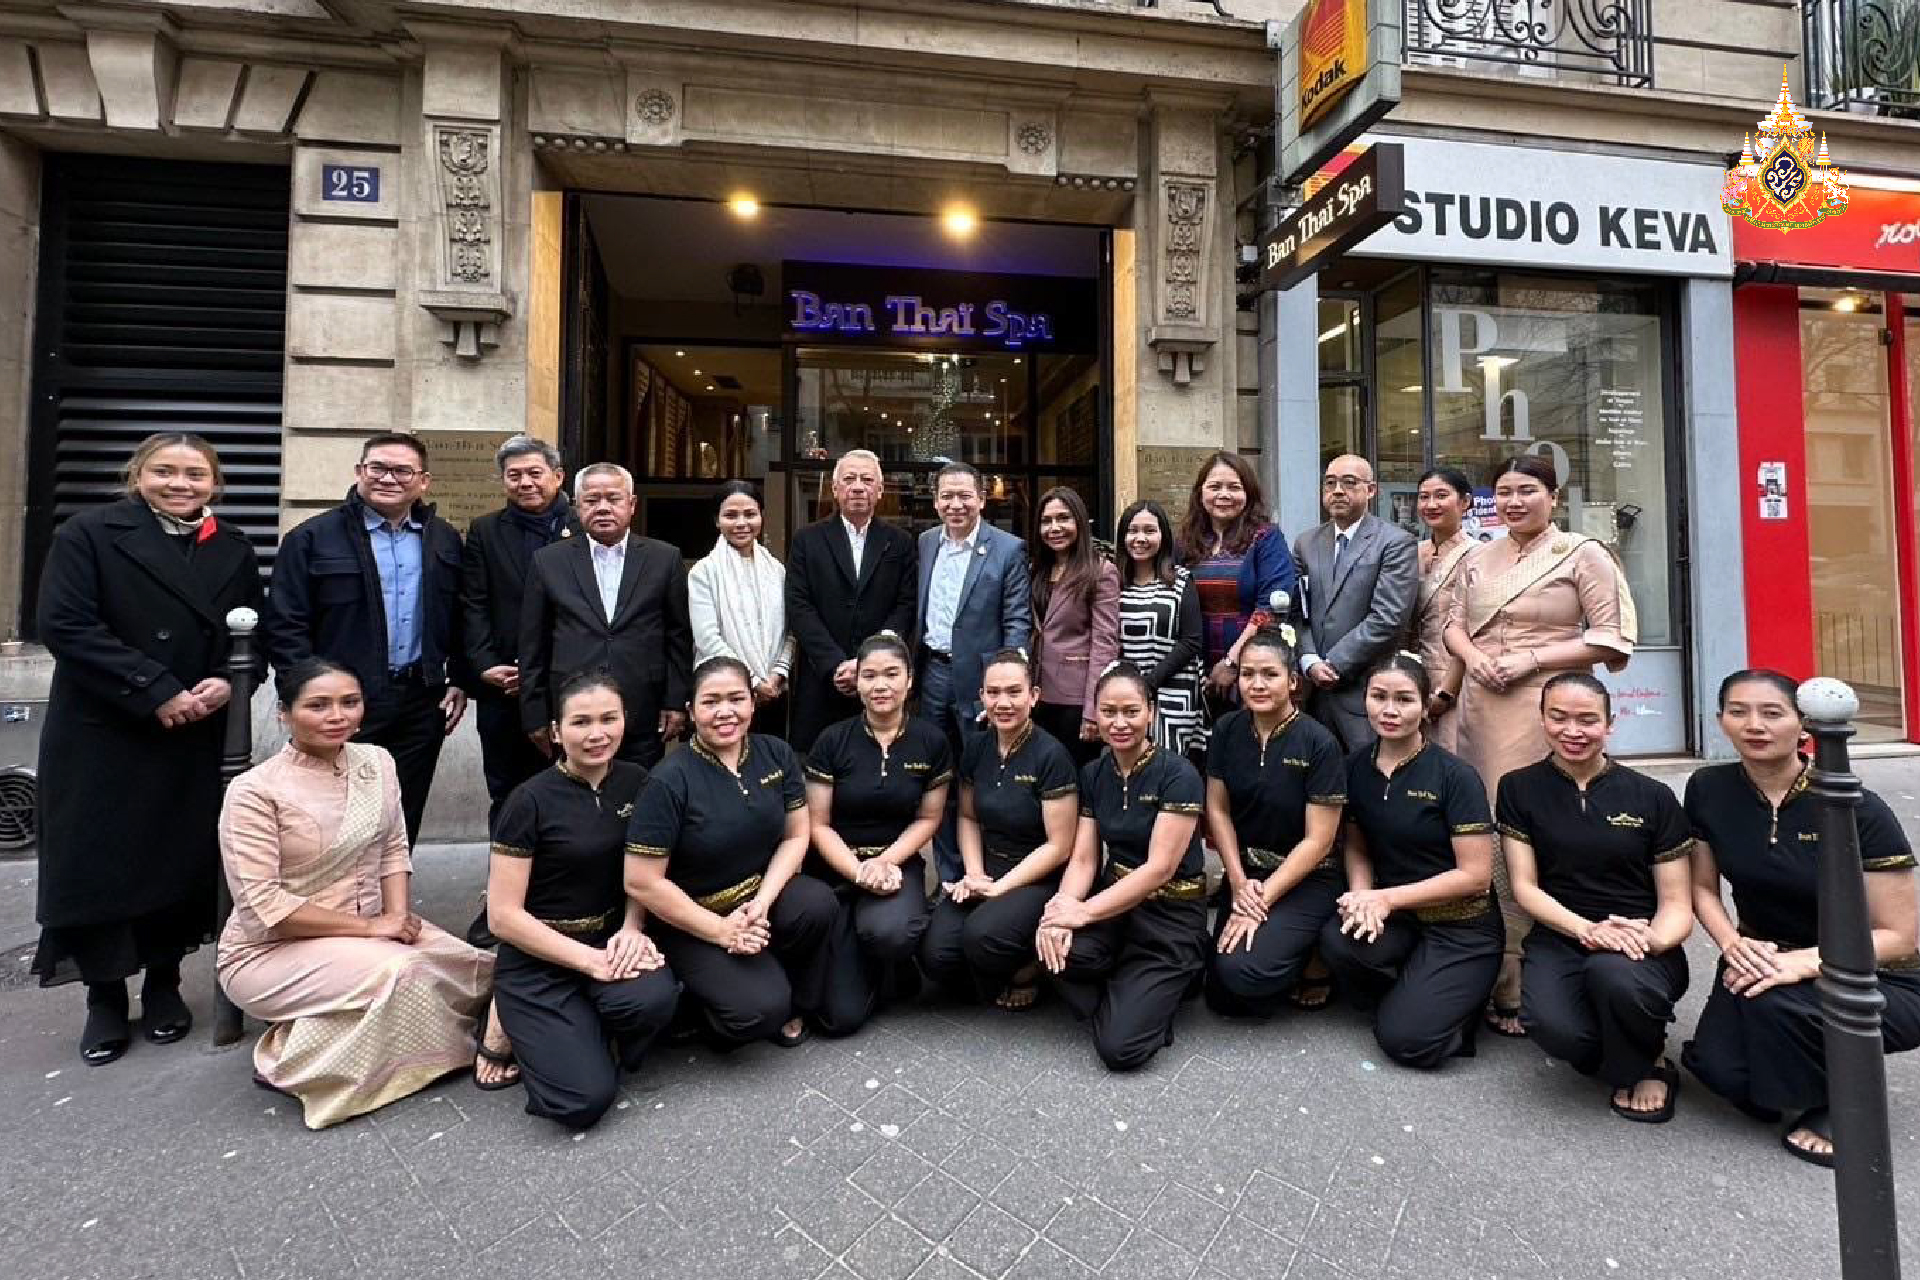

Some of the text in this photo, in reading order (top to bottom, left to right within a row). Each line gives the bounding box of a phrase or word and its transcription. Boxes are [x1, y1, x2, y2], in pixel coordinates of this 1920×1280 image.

[331, 169, 370, 198] 25
[1267, 234, 1296, 270] Ban
[1336, 174, 1372, 216] Spa
[1394, 189, 1579, 246] STUDIO
[1599, 205, 1718, 256] KEVA
[790, 290, 876, 330] Ban
[983, 299, 1053, 346] Spa
